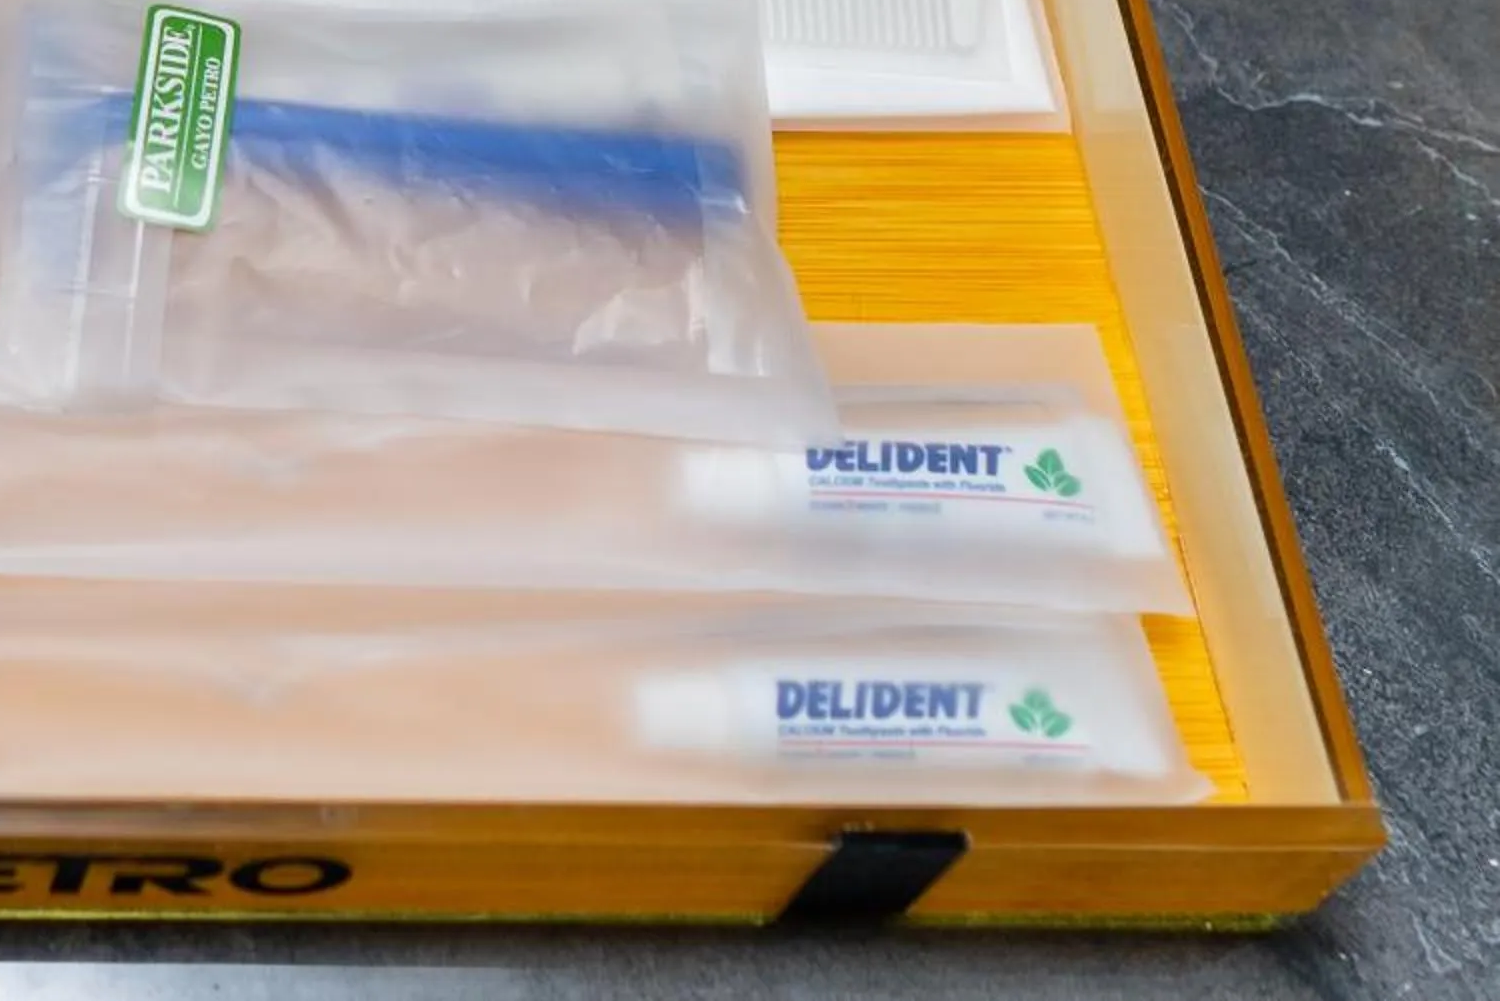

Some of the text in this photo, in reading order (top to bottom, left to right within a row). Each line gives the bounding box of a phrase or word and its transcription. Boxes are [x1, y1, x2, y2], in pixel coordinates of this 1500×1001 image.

[141, 25, 194, 193] PARKSIDE
[191, 57, 222, 170] GAYO PETRO
[806, 440, 1002, 476] DELIDENT
[776, 680, 985, 720] DELIDENT
